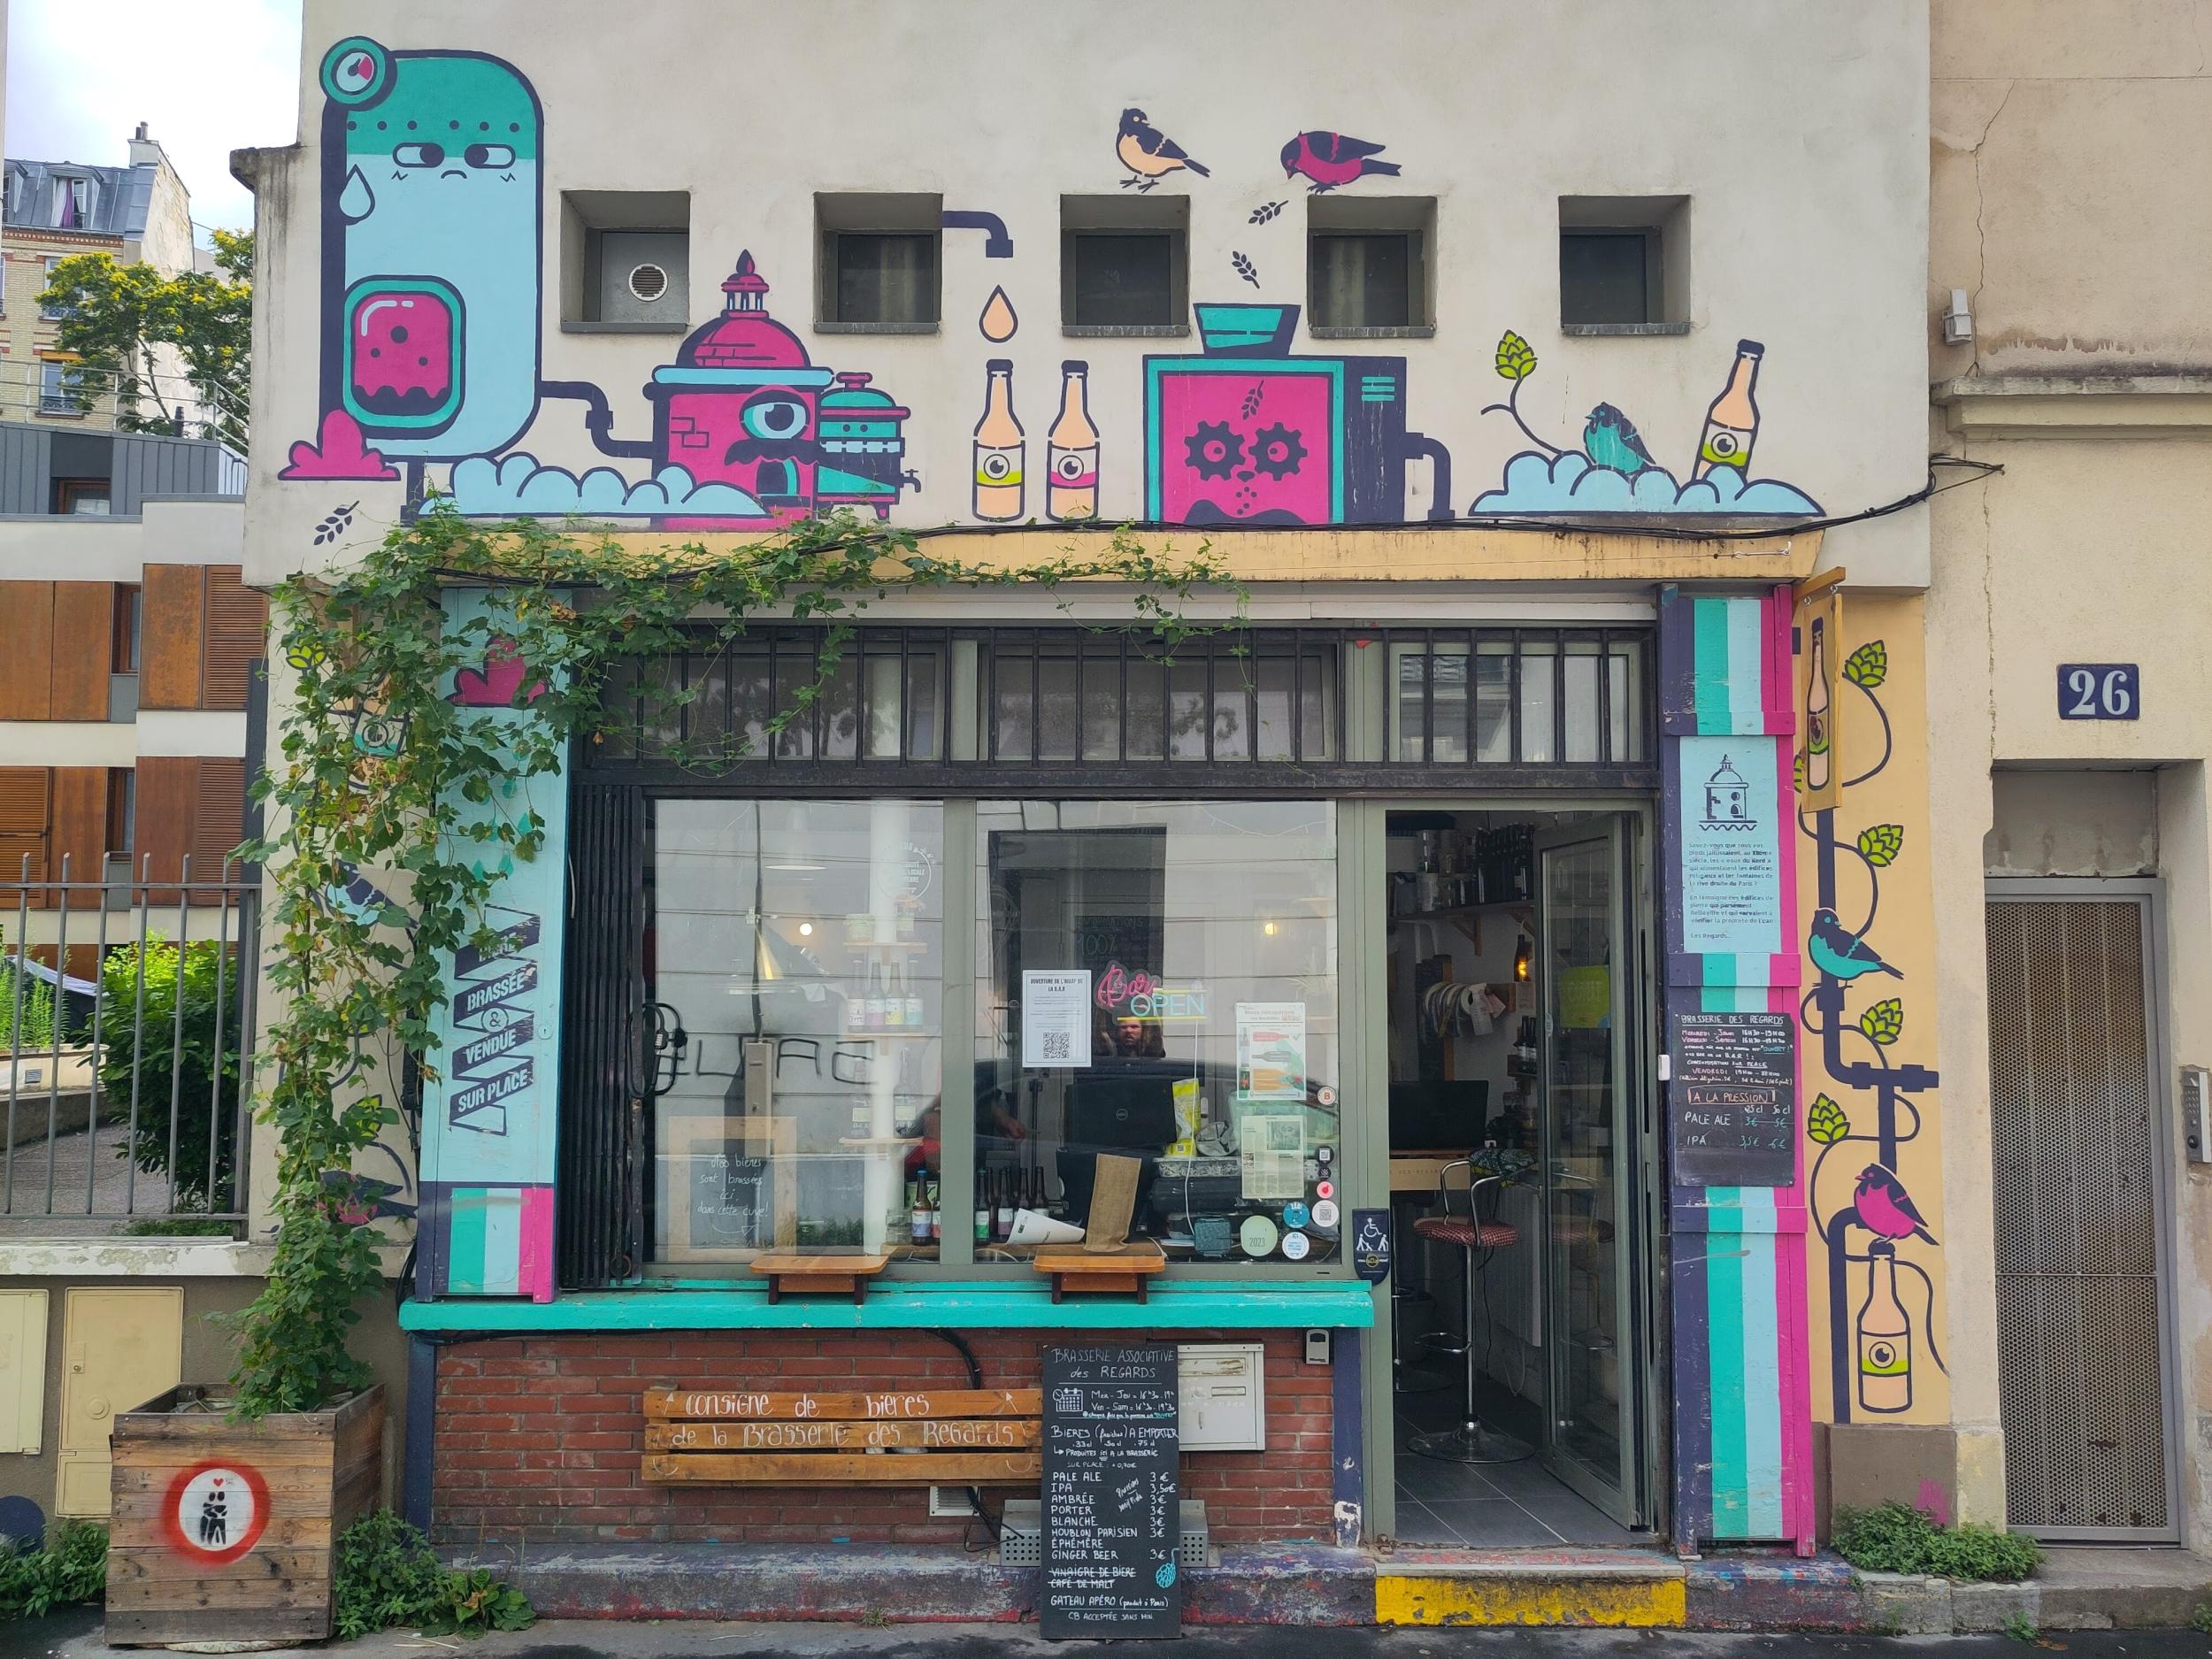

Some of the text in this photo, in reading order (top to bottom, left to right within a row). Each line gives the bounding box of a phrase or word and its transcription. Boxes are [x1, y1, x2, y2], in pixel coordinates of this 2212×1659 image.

[2069, 670, 2131, 715] 26
[467, 971, 526, 1012] BRASSÉE
[1131, 993, 1204, 1017] OPEN
[489, 1011, 501, 1027] &
[1680, 1015, 1784, 1025] BRASSERIE DES REGARDS
[465, 1028, 516, 1064] VENDUE
[458, 1068, 528, 1113] SUR PLACE
[1694, 1092, 1769, 1103] A LA PRESSION
[1685, 1111, 1710, 1125] PALE
[1714, 1113, 1731, 1125] ALE
[1686, 1135, 1707, 1146] IPA
[1050, 1348, 1175, 1363] BRASSERIE ASSOCIATIVE
[1070, 1366, 1156, 1379] des REGARDS
[795, 1394, 819, 1417] de
[1091, 1402, 1104, 1411] Ven
[1111, 1402, 1129, 1411] Sam
[672, 1425, 697, 1446] de
[713, 1425, 727, 1446] la
[869, 1422, 901, 1447] des
[1053, 1471, 1170, 1482] PALE ALE 3 €
[1050, 1483, 1072, 1493] IPA
[1051, 1493, 1094, 1504] AMBRÉE
[1149, 1494, 1167, 1505] 3€
[1050, 1505, 1165, 1516] PORTER 3€
[1050, 1517, 1165, 1527] BLANCHE 3€
[1051, 1527, 1165, 1538] HOUBLON PARISIEN 3€
[1051, 1548, 1167, 1560] GINGER BEER 3€
[1050, 1564, 1097, 1578] VINAIGRE
[1099, 1566, 1110, 1577] DE
[1050, 1577, 1116, 1589] CAFÉ DE MALT
[1050, 1595, 1086, 1606] GATEAU
[1088, 1594, 1116, 1606] APÉRO
[1068, 1611, 1080, 1620] CB
[1083, 1611, 1118, 1622] ACCEPTÉE
